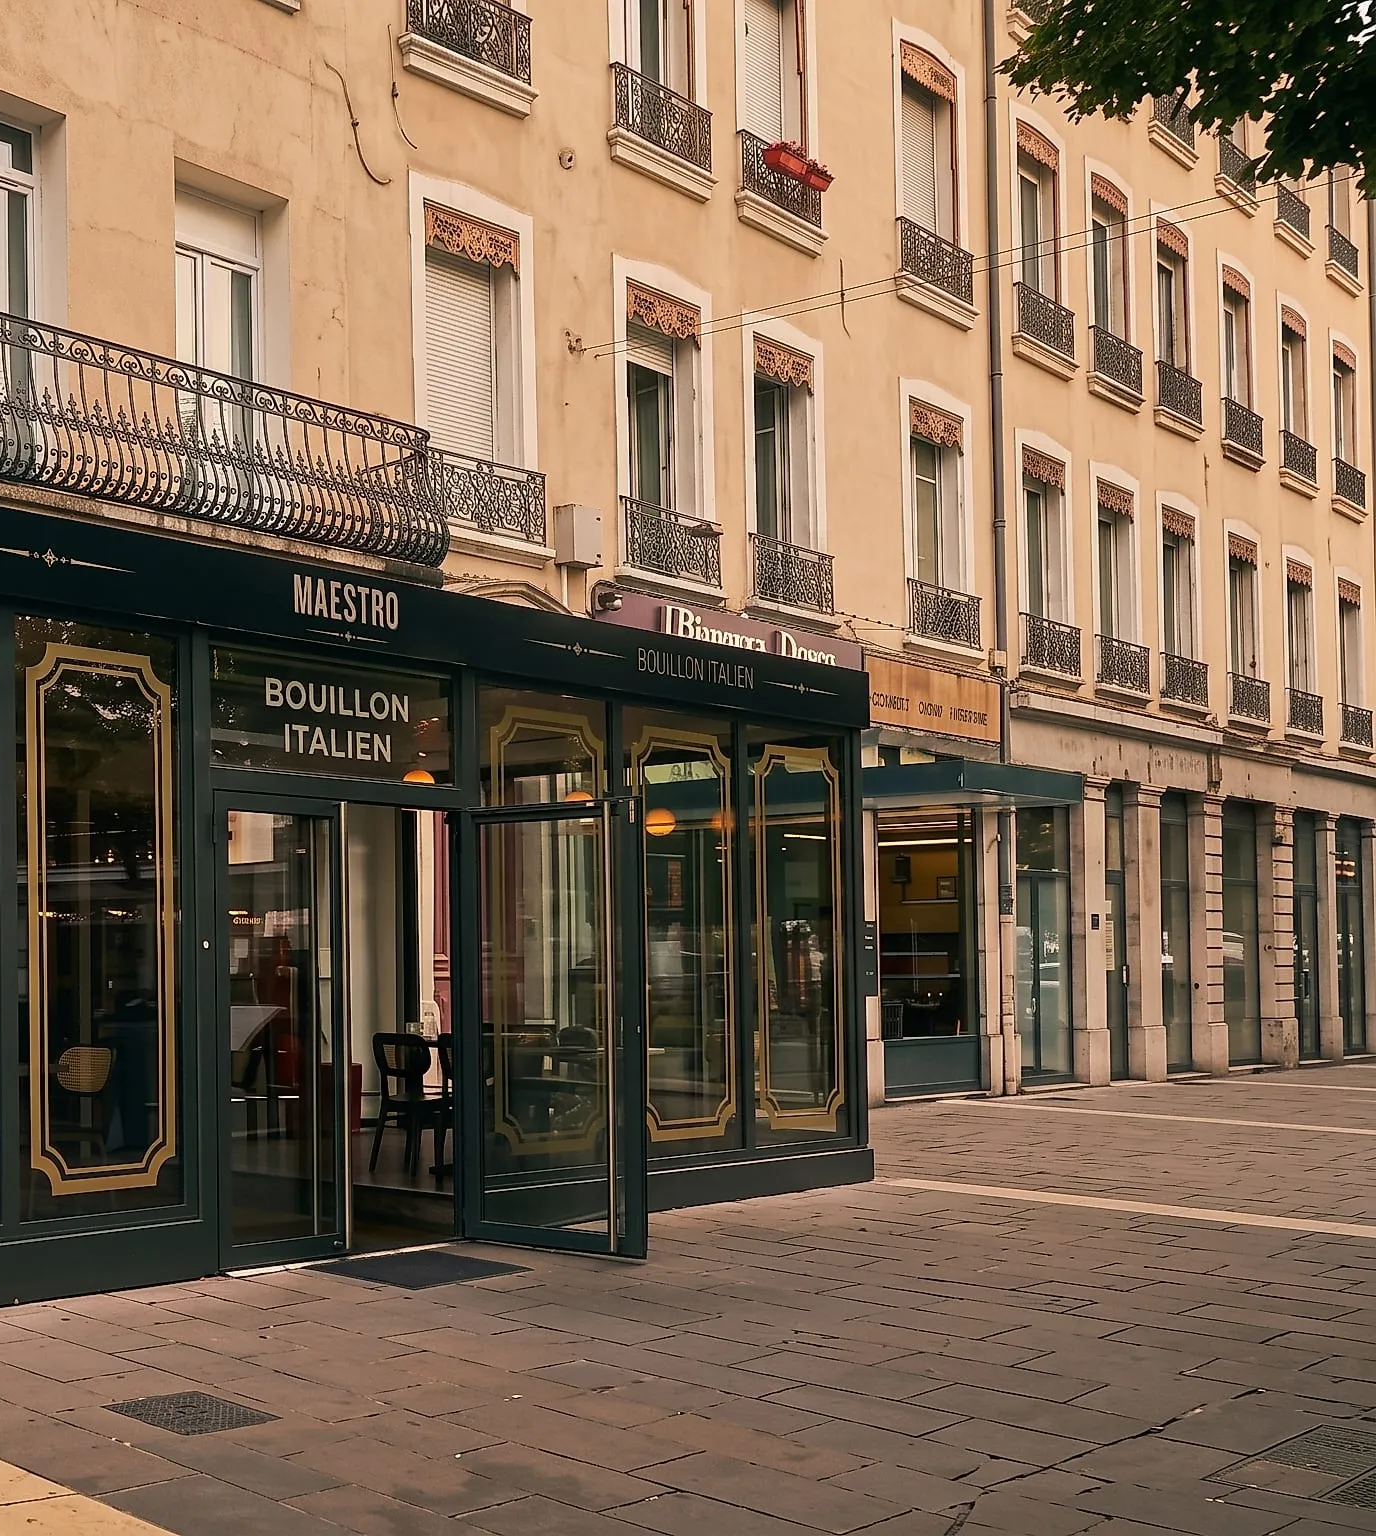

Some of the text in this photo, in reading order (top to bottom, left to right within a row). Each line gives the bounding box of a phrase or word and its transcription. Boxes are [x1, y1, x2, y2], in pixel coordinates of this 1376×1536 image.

[293, 573, 399, 631] MAESTRO
[638, 647, 754, 690] BOUILLON ITALIEN
[265, 677, 409, 723] BOUILLON
[284, 723, 392, 763] ITALIEN
